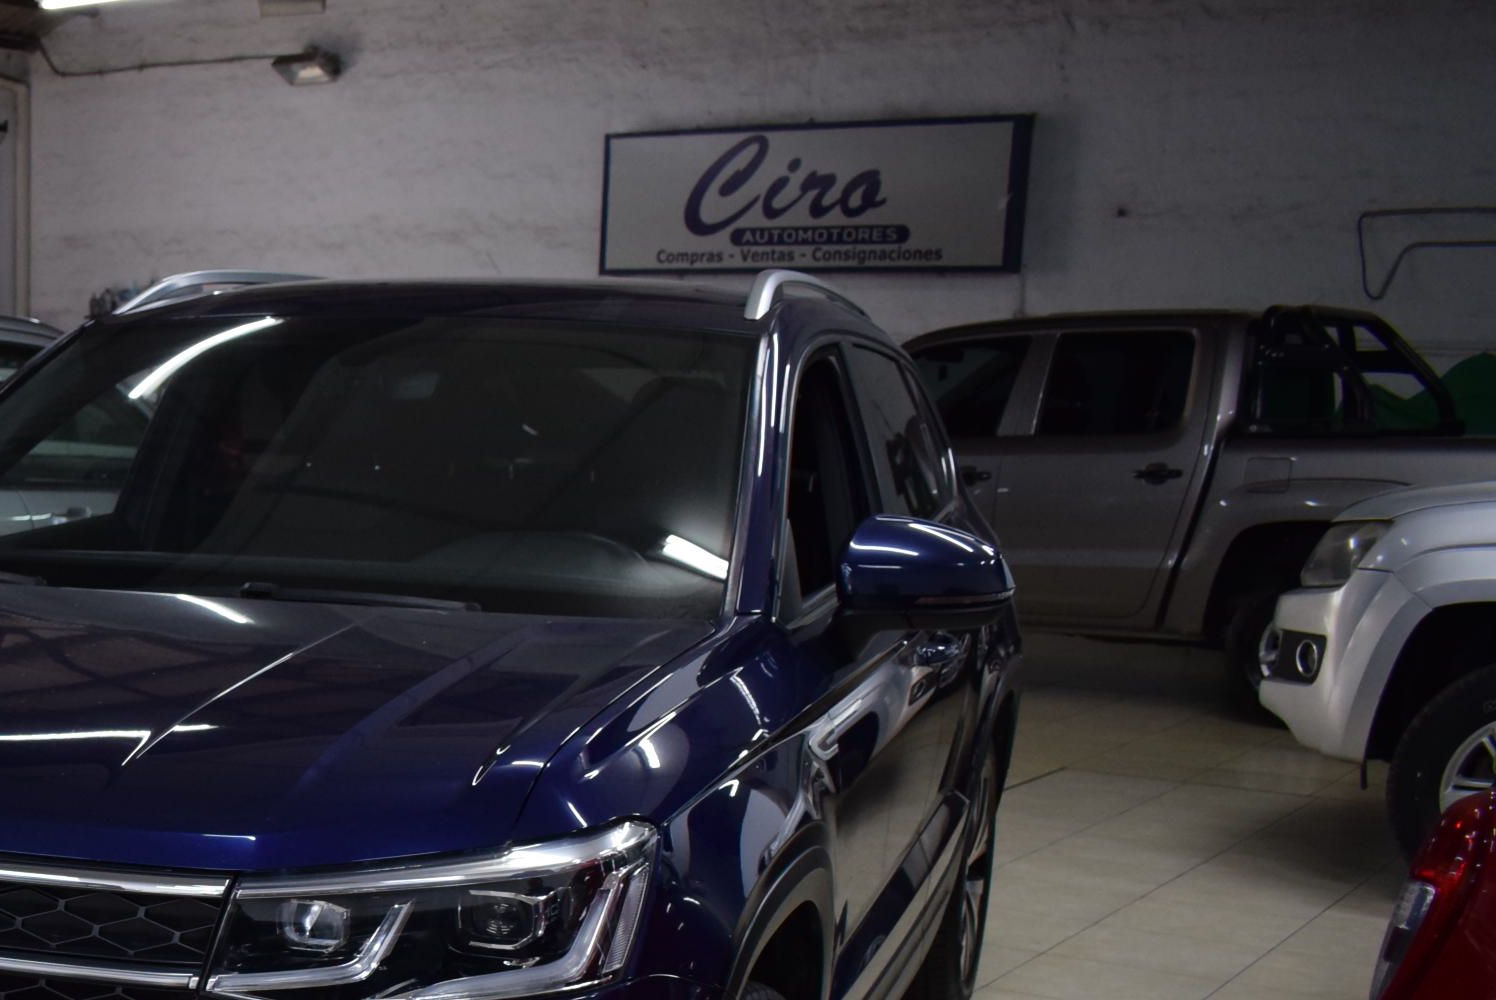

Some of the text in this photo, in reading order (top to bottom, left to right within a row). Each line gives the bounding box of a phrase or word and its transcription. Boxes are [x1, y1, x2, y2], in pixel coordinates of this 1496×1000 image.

[684, 134, 887, 237] Ciro
[741, 227, 898, 244] AUTOMOTORES
[656, 249, 724, 268] Compras
[740, 248, 795, 264] Ventas
[812, 246, 944, 266] Consignaciones
